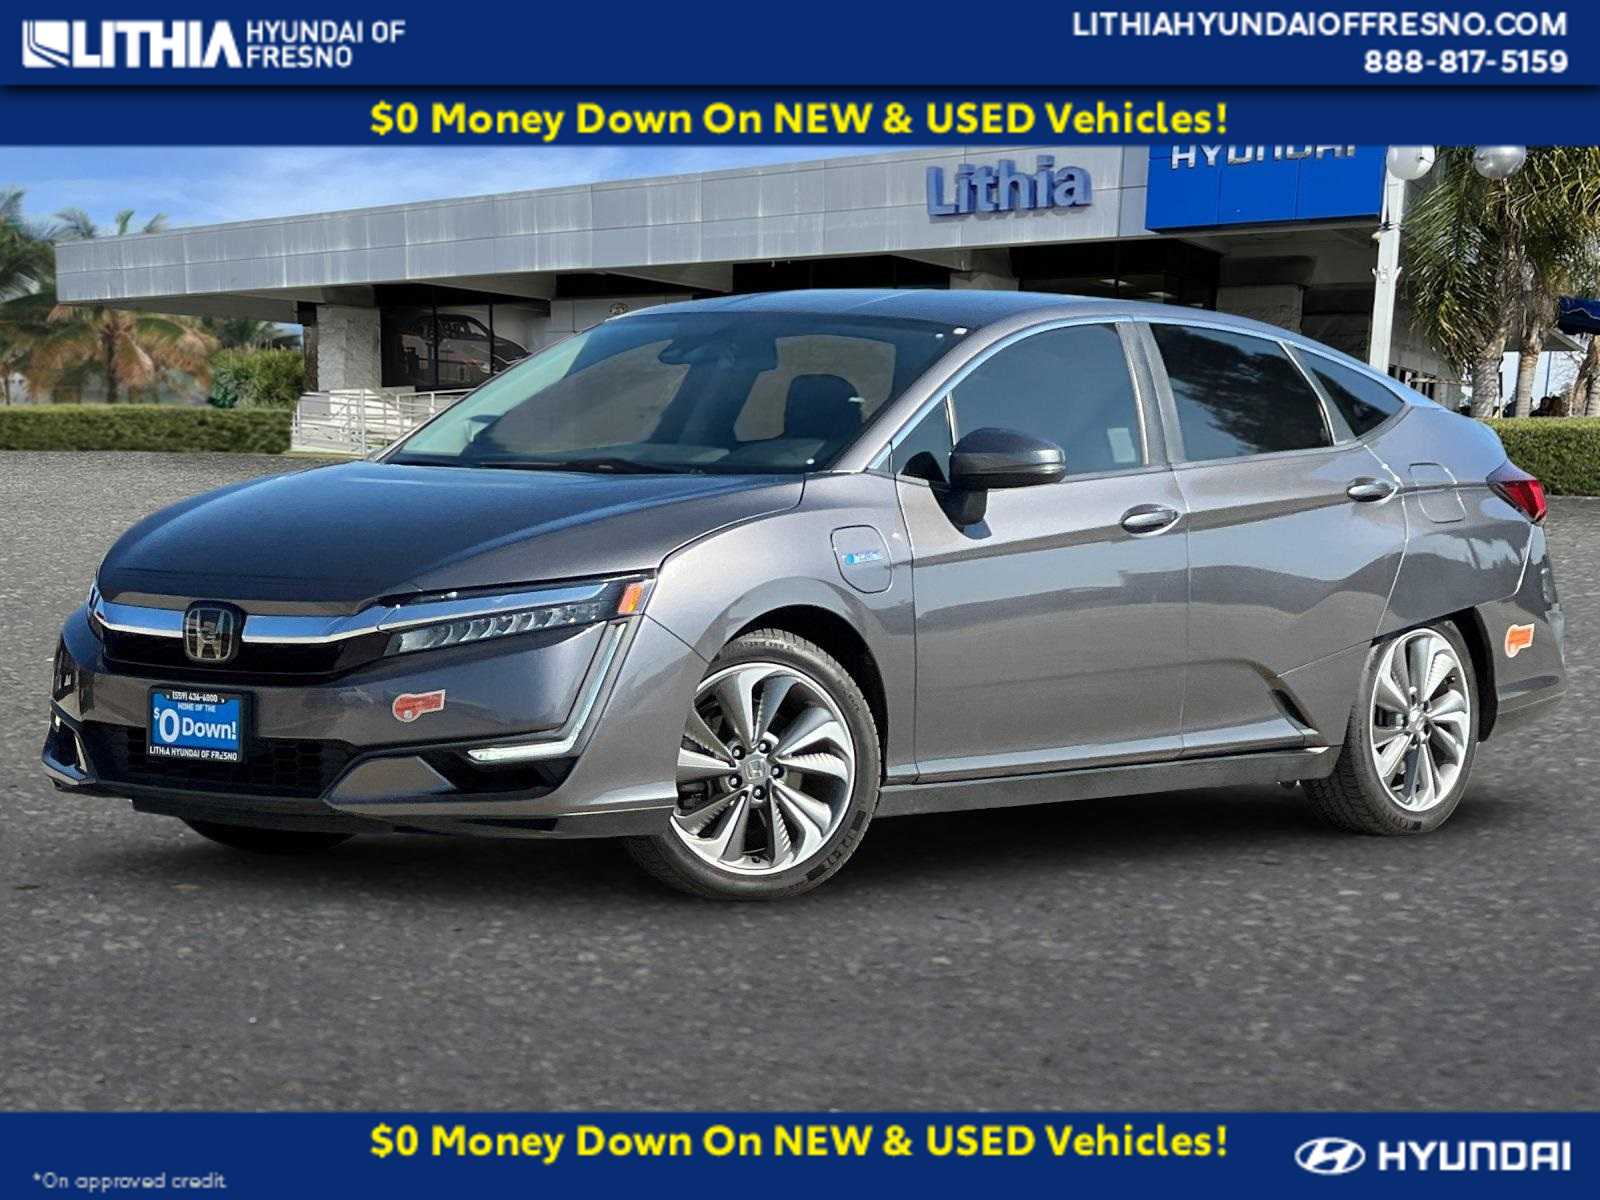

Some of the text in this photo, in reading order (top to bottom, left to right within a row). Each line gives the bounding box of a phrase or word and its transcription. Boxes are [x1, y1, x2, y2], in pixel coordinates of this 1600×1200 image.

[926, 155, 1092, 215] Lithia
[182, 717, 237, 740] Down!
[149, 746, 238, 761] LITHIA HYUNDAI OF FRESNO
